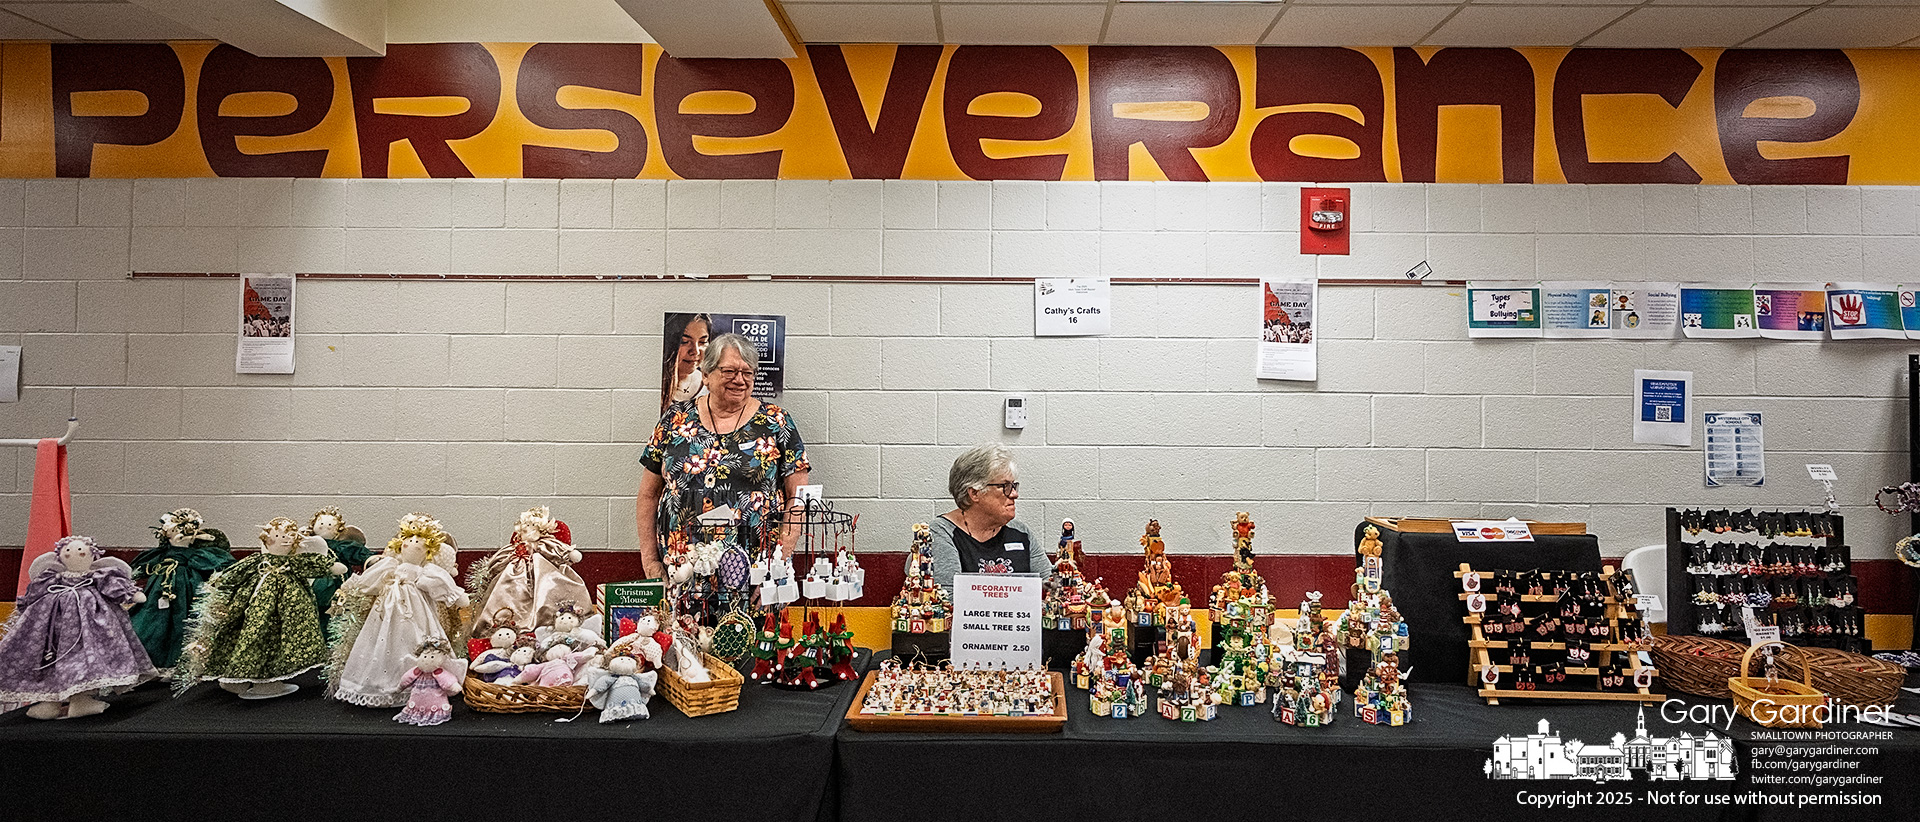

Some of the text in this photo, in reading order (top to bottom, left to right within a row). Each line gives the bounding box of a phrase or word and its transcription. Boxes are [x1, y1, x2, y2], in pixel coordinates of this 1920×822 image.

[1491, 294, 1511, 303] Types
[1044, 307, 1101, 316] Cathy's Crafts
[1490, 310, 1518, 320] Bullying
[741, 323, 769, 335] 988
[614, 587, 654, 596] Christmas
[971, 584, 1023, 592] DECORATIVE
[620, 596, 648, 604] Mouse
[1015, 624, 1031, 632] $25
[962, 643, 1008, 651] ORNAMENT
